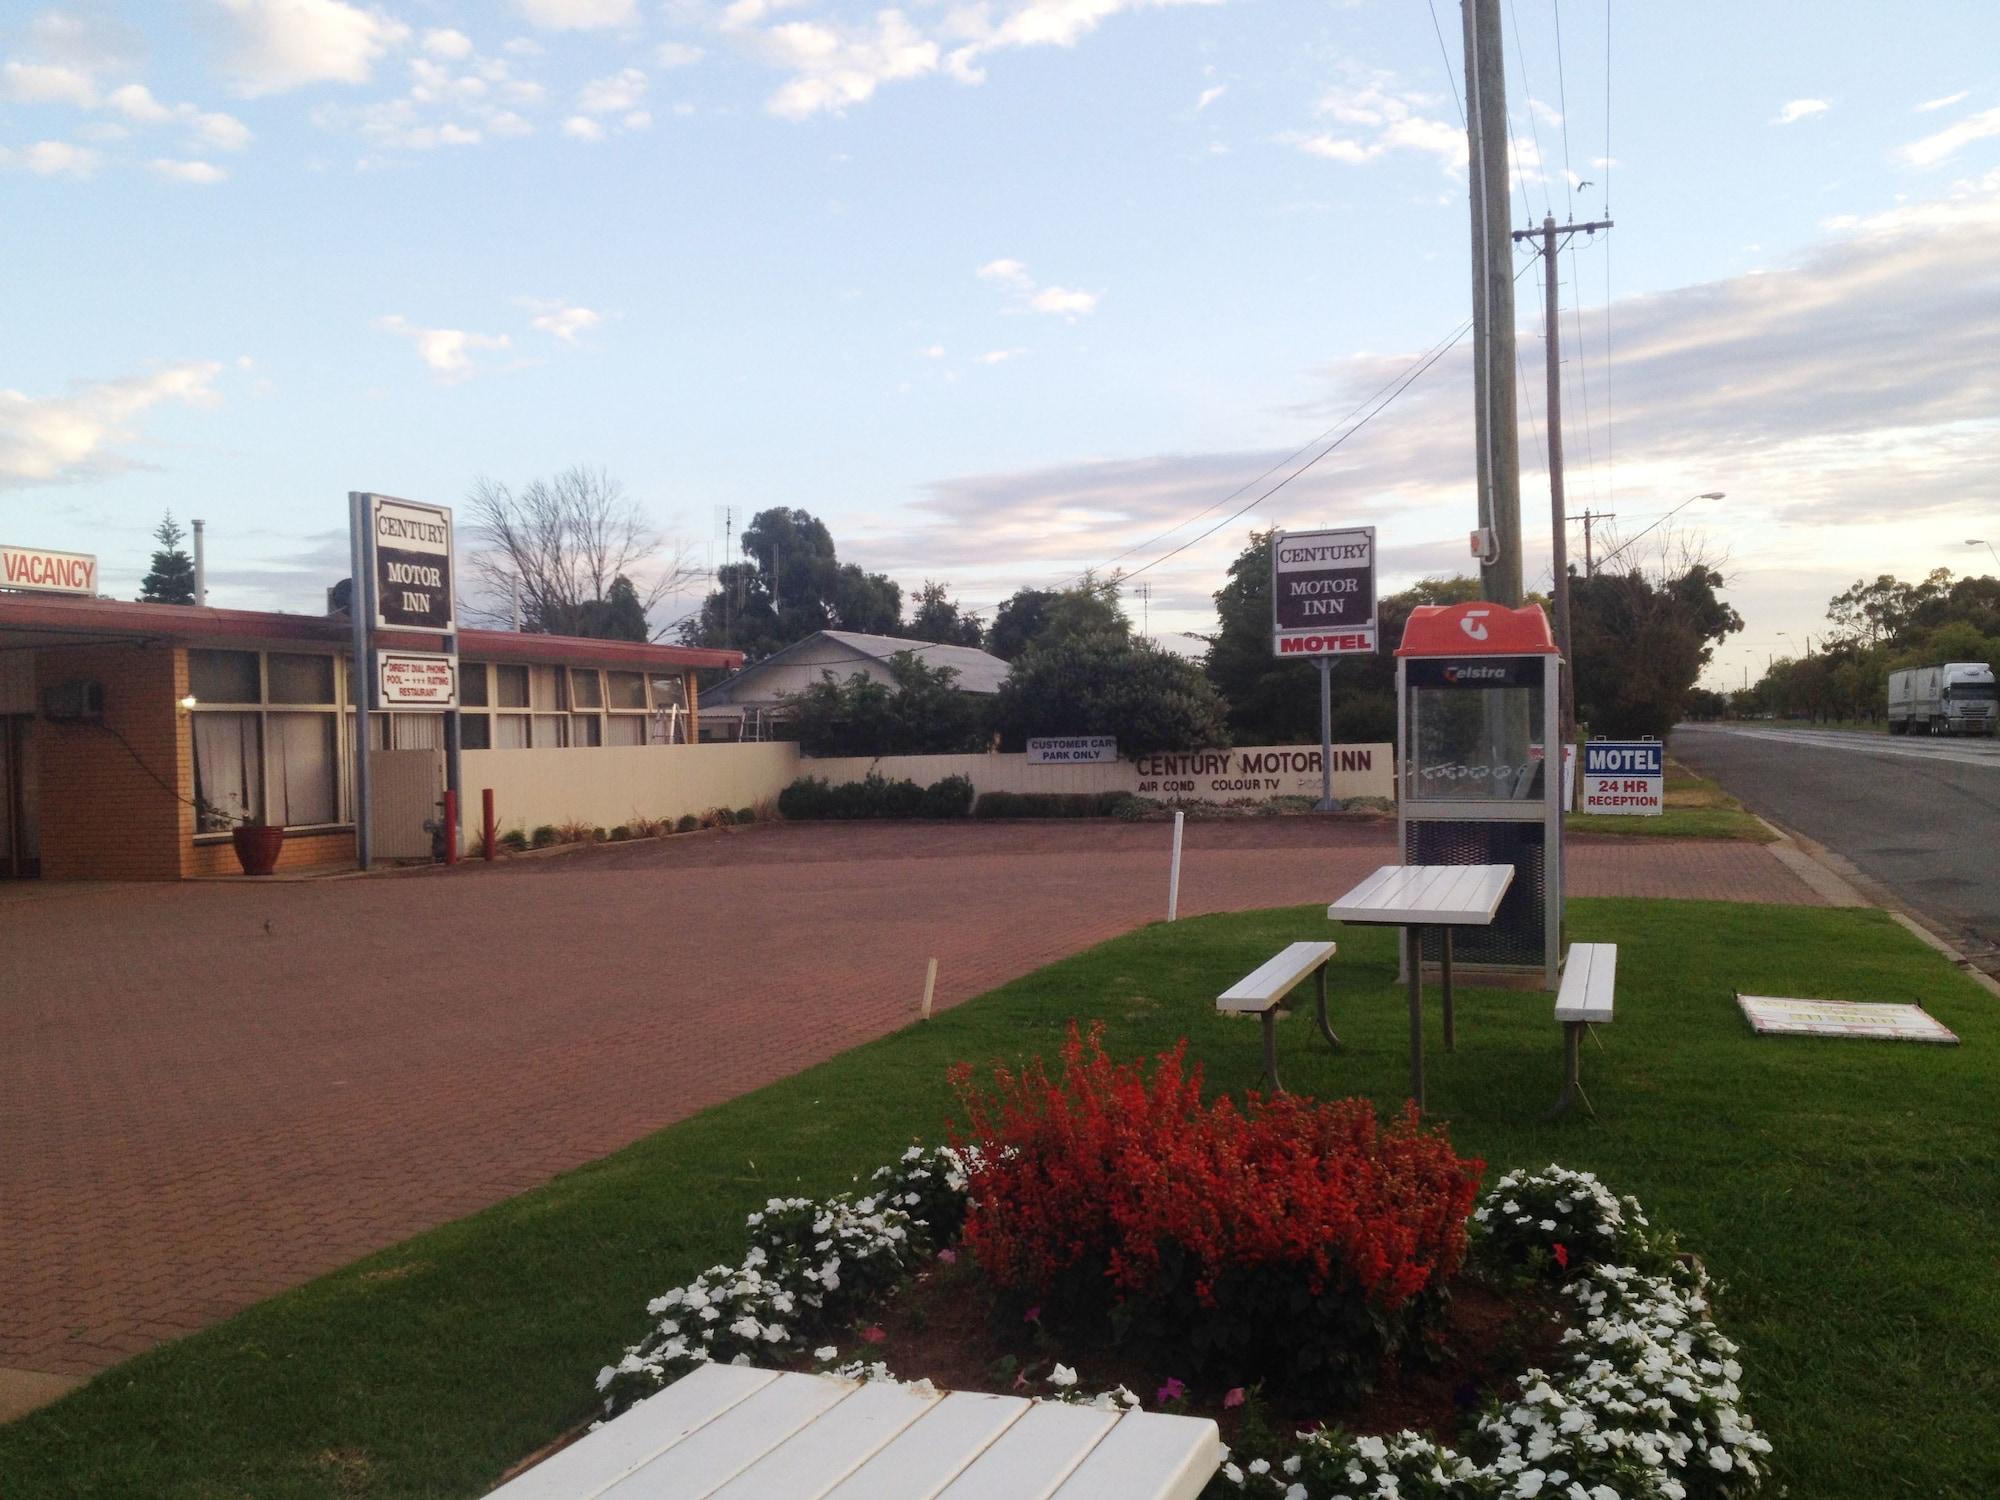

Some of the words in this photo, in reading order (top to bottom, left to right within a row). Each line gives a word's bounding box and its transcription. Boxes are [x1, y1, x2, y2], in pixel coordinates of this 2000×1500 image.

[378, 515, 445, 544] CENTURY
[1280, 543, 1368, 563] CENTURY
[3, 552, 95, 588] VACANCY
[387, 562, 441, 587] MOTOR
[1290, 578, 1358, 596] MOTOR
[402, 591, 430, 613] INN
[1303, 598, 1345, 616] INN
[1280, 634, 1372, 653] MOTEL
[387, 675, 403, 684] POOL
[1446, 666, 1506, 682] Telstra
[399, 688, 438, 697] RESTAURANT
[1031, 740, 1088, 749] CUSTOMER
[1091, 739, 1113, 747] CAR
[1042, 752, 1070, 760] PARK
[1072, 751, 1101, 759] ONLY
[1137, 754, 1231, 776] CENTURY
[1242, 752, 1323, 773] MOTOR
[1333, 750, 1371, 771] INN
[1589, 749, 1659, 770] MOTEL
[1138, 782, 1158, 792] AIR
[1163, 781, 1195, 791] COND
[1211, 780, 1261, 790] COLOUR
[1264, 779, 1280, 789] TV
[1599, 781, 1618, 792] 24
[1623, 781, 1648, 792] HR
[1588, 796, 1658, 806] RECEPTION
